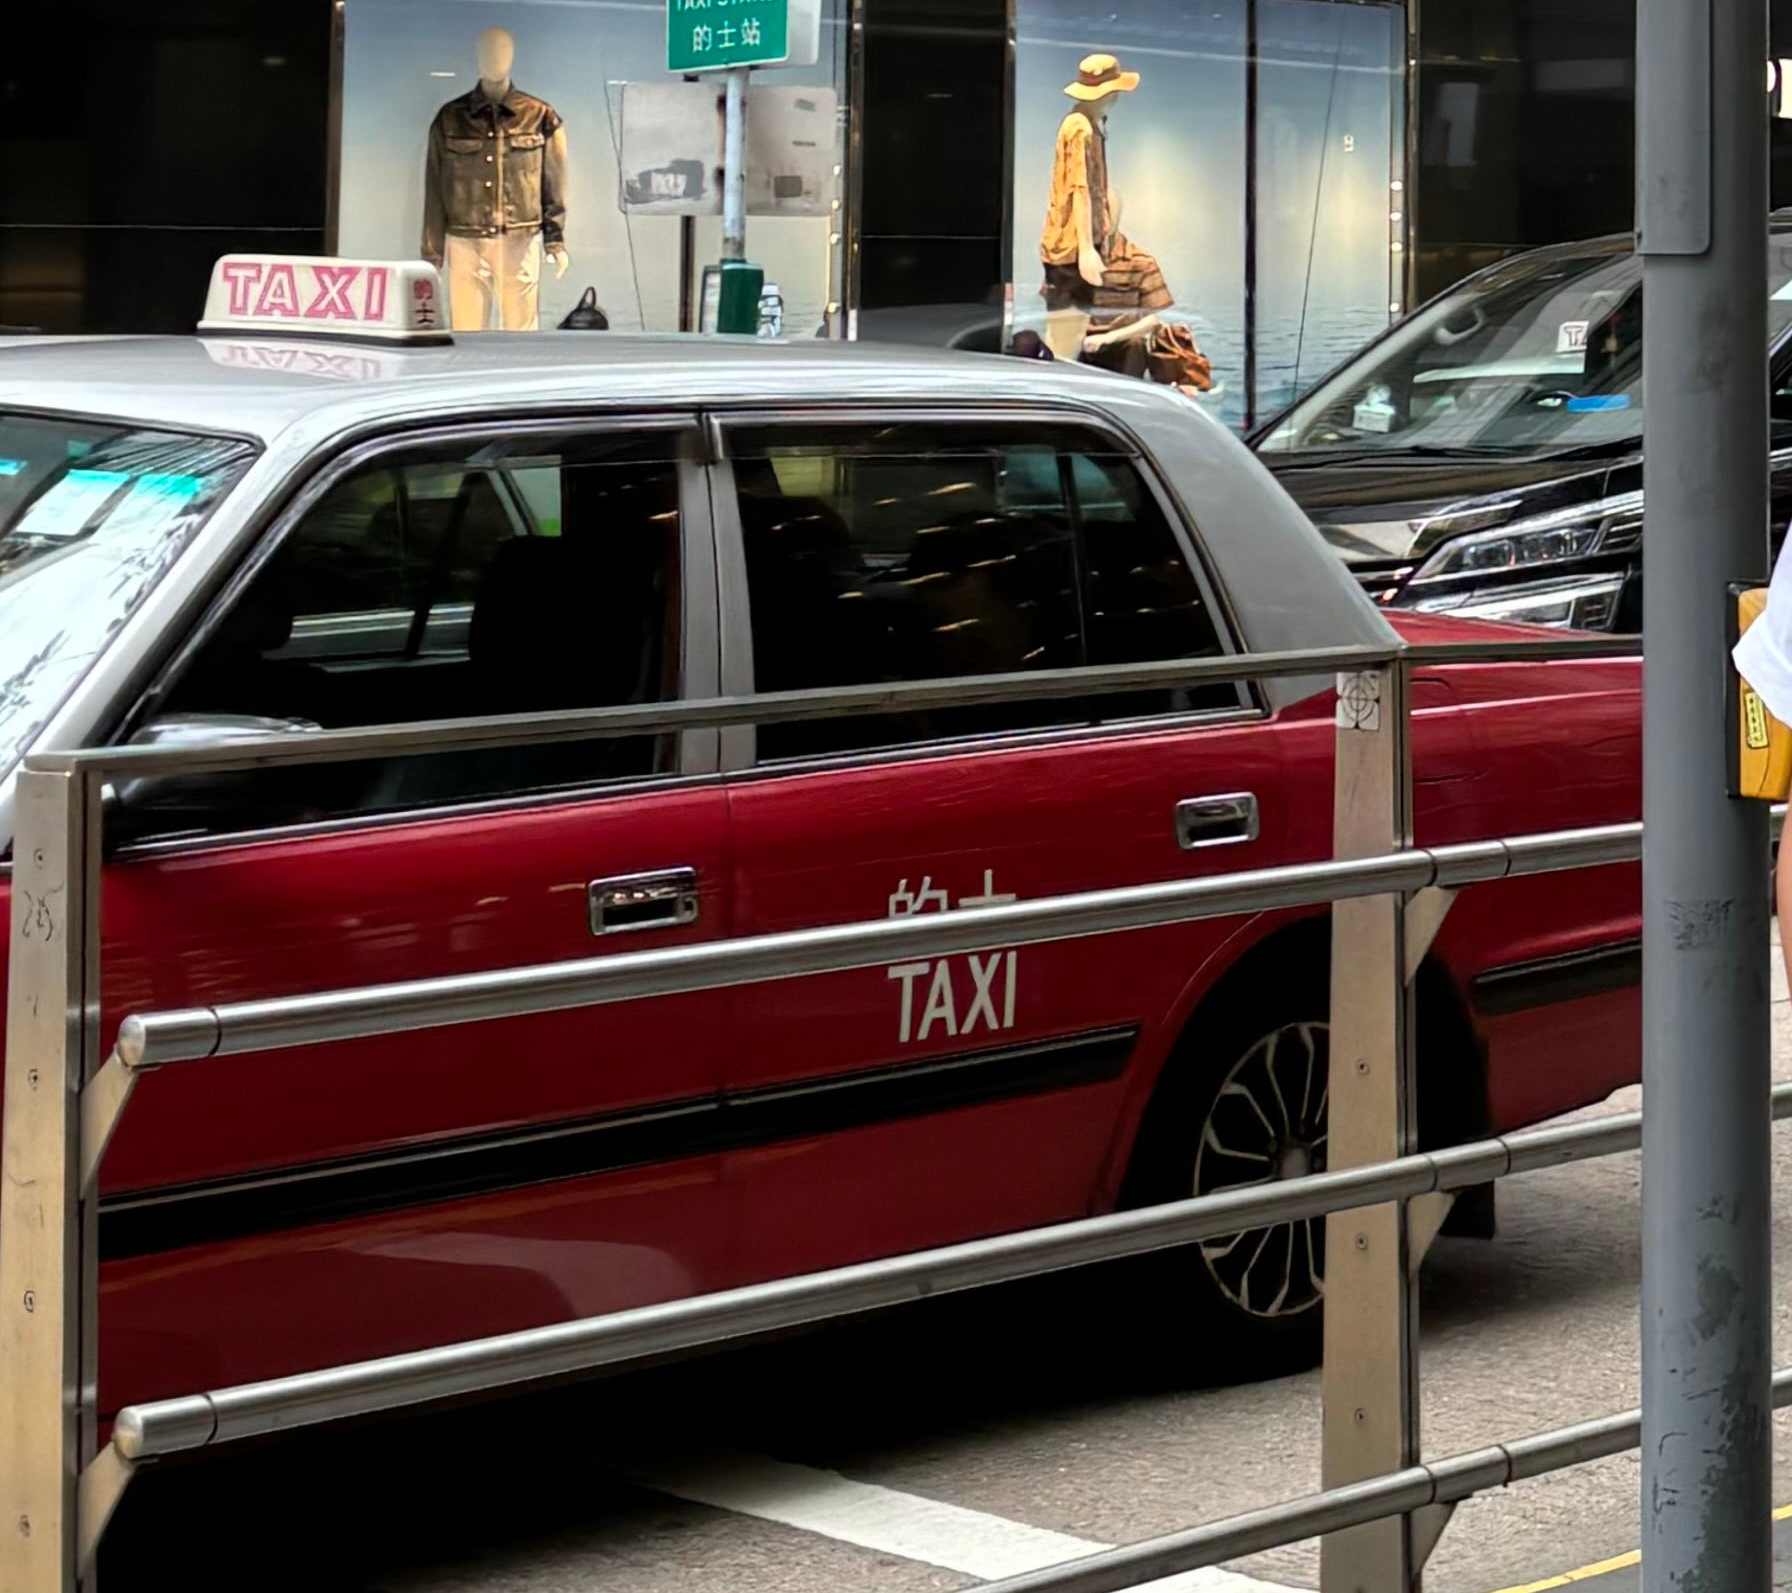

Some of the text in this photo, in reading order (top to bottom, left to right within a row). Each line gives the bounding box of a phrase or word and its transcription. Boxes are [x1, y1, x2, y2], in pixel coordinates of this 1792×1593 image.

[693, 17, 760, 53] 的士站
[222, 262, 389, 321] TAXI
[887, 950, 1017, 1043] TAXI
